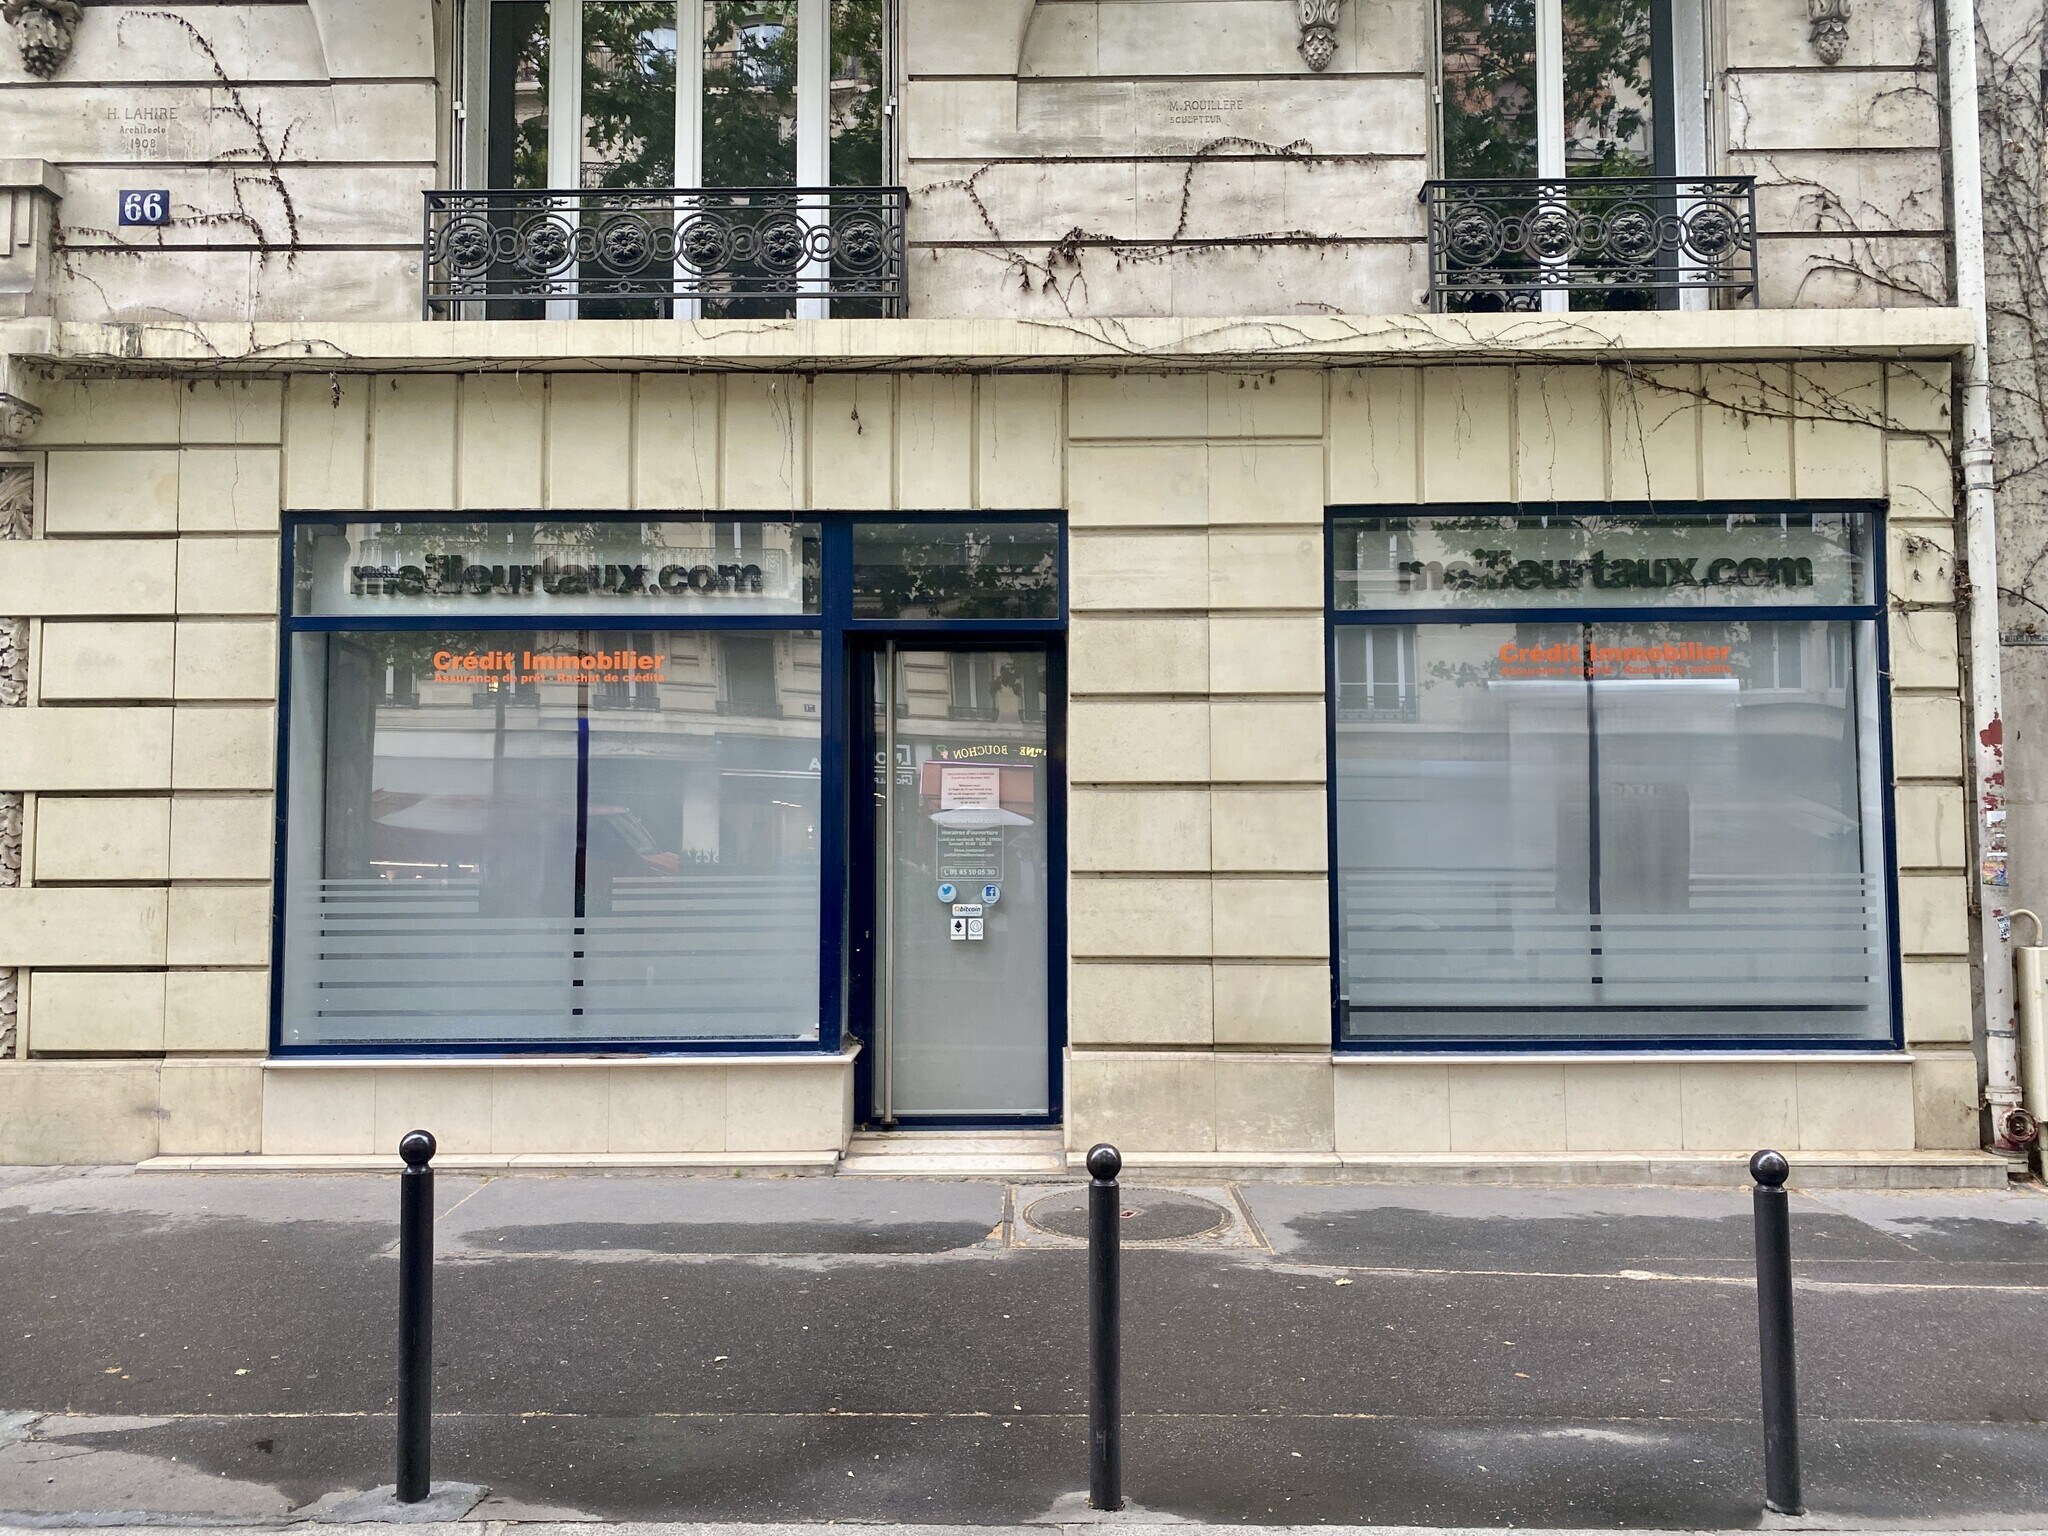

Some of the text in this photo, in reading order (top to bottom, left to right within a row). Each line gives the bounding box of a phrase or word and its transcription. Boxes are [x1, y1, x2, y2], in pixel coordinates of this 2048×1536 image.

[106, 107, 178, 119] H. LAHIRE
[1169, 114, 1222, 124] SCULPTEUR
[130, 138, 156, 149] 1908
[123, 192, 163, 222] 66
[1500, 642, 1731, 663] Crédit Immobilier
[433, 651, 665, 670] Crédit Immobilier
[434, 673, 499, 683] Assurance
[502, 673, 517, 683] de
[521, 673, 545, 685] prêt
[557, 673, 600, 683] Rachat
[604, 673, 618, 683] de
[622, 673, 666, 683] crédits
